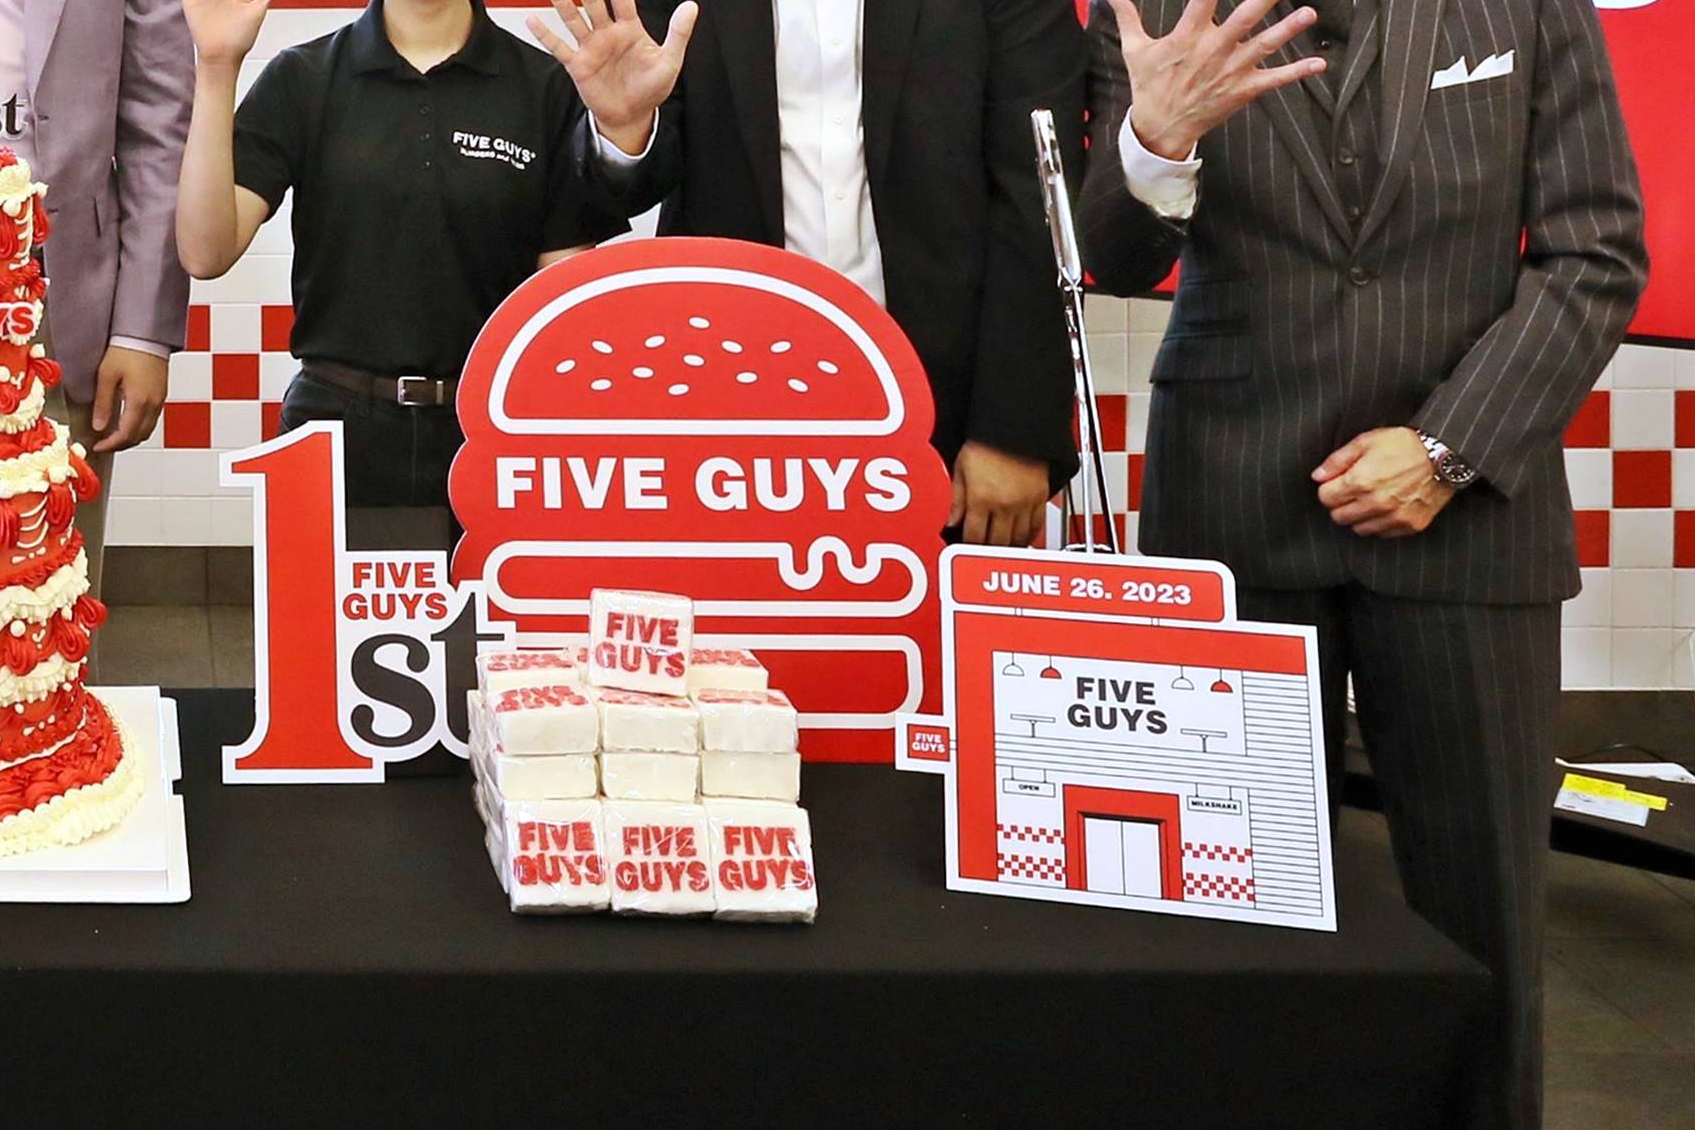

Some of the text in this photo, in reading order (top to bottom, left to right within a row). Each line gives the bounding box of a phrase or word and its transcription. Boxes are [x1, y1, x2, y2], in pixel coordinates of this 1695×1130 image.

[453, 132, 491, 149] FIVE
[493, 138, 532, 163] GUYS
[496, 455, 912, 512] FIVE GUYS
[353, 562, 436, 588] FIVE
[983, 570, 1192, 605] JUNE 26. 2023
[343, 593, 448, 621] GUYS
[606, 612, 679, 646] FIVE
[595, 642, 685, 678] GUYS
[1076, 676, 1157, 706] FIVE
[1067, 703, 1168, 735] GUYS
[912, 741, 946, 754] GUYS
[915, 733, 942, 745] FIVE
[1191, 800, 1239, 811] MILKSHAKE
[518, 821, 595, 852] FIVE
[622, 826, 697, 857] FIVE
[723, 826, 798, 857] FIVE
[513, 854, 604, 887] GUYS
[615, 860, 710, 892] GUYS
[719, 859, 813, 892] GUYS
